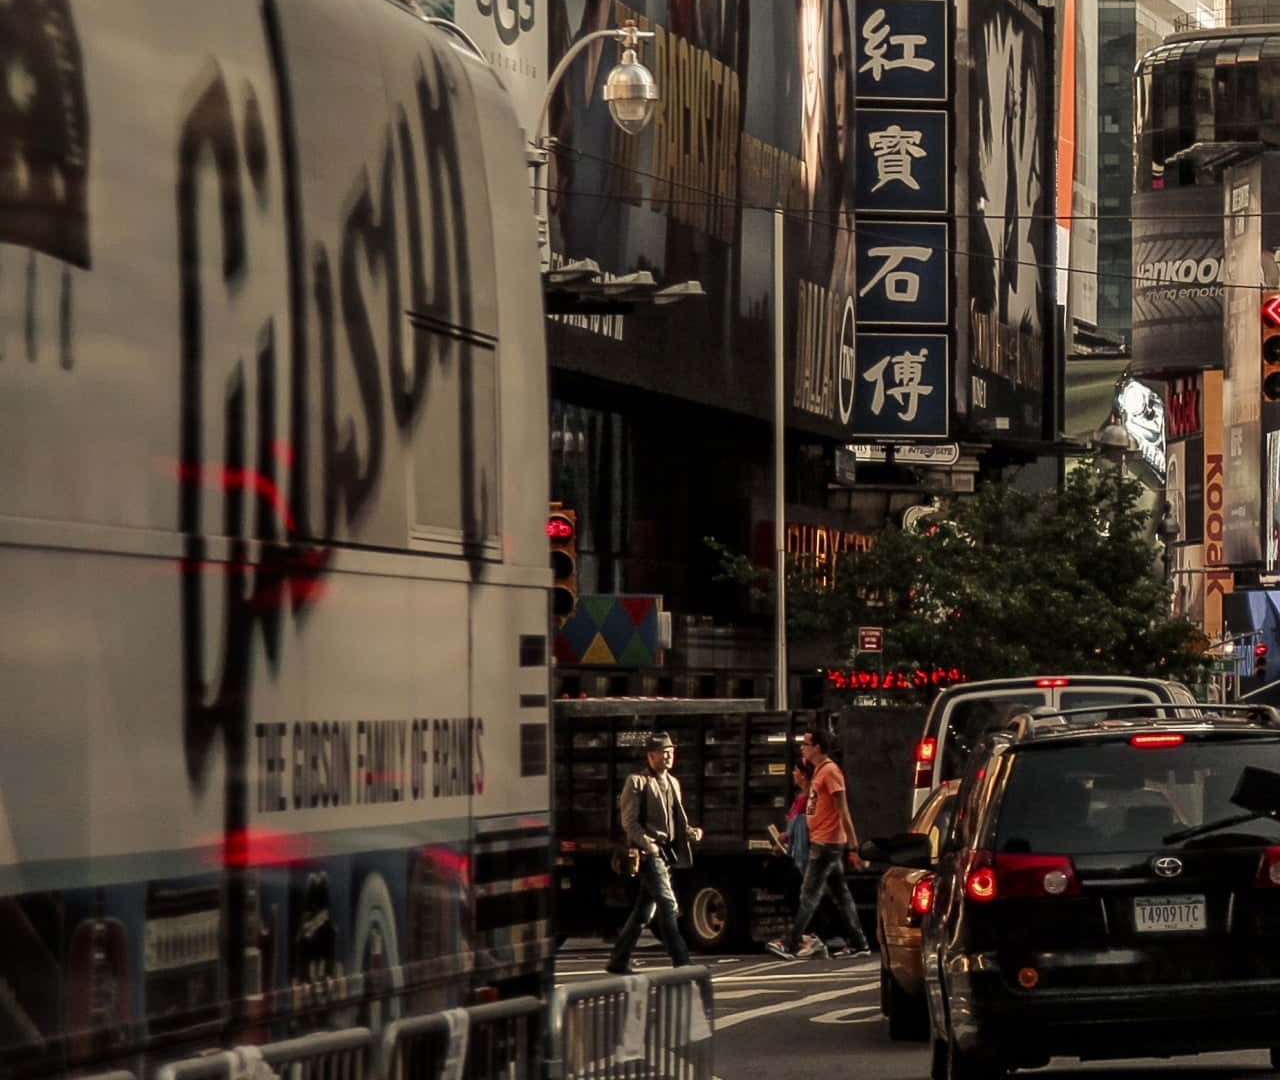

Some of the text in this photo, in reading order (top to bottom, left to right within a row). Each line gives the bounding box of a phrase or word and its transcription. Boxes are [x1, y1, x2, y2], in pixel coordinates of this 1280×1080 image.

[1205, 454, 1232, 607] Kodak
[255, 721, 287, 814] THE
[292, 720, 352, 810] GIBSON
[356, 719, 406, 805] FAMILY
[411, 718, 428, 802] OF
[1140, 904, 1199, 924] T490917C
